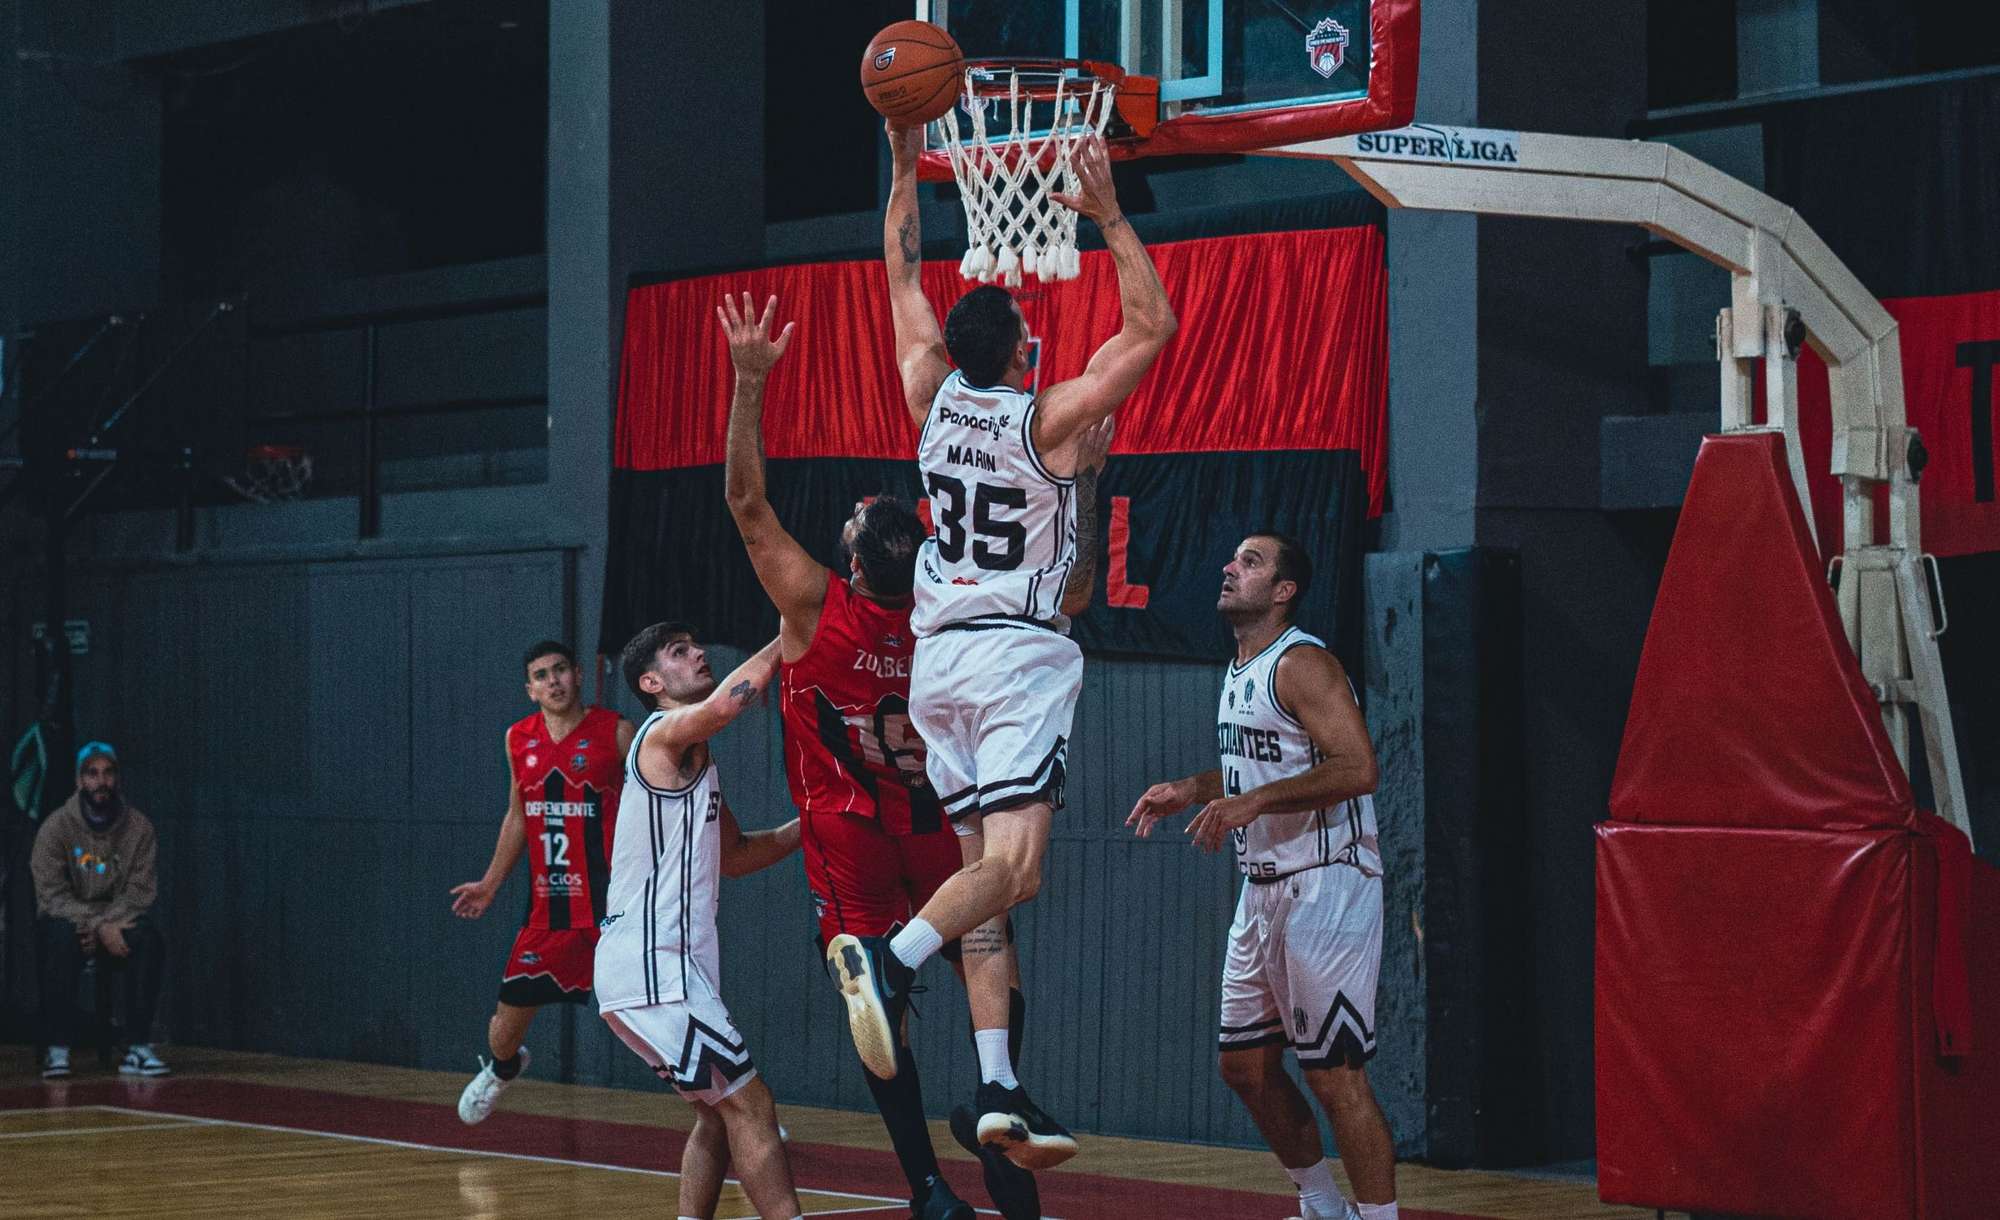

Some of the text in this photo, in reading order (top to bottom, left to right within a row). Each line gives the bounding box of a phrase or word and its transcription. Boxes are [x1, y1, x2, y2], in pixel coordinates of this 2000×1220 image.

[1357, 132, 1449, 159] SUPER
[946, 444, 996, 472] MARIN
[927, 472, 1028, 571] 35
[853, 648, 914, 679] ZULBE
[1217, 722, 1283, 763] DIANTES
[539, 832, 571, 866] 12
